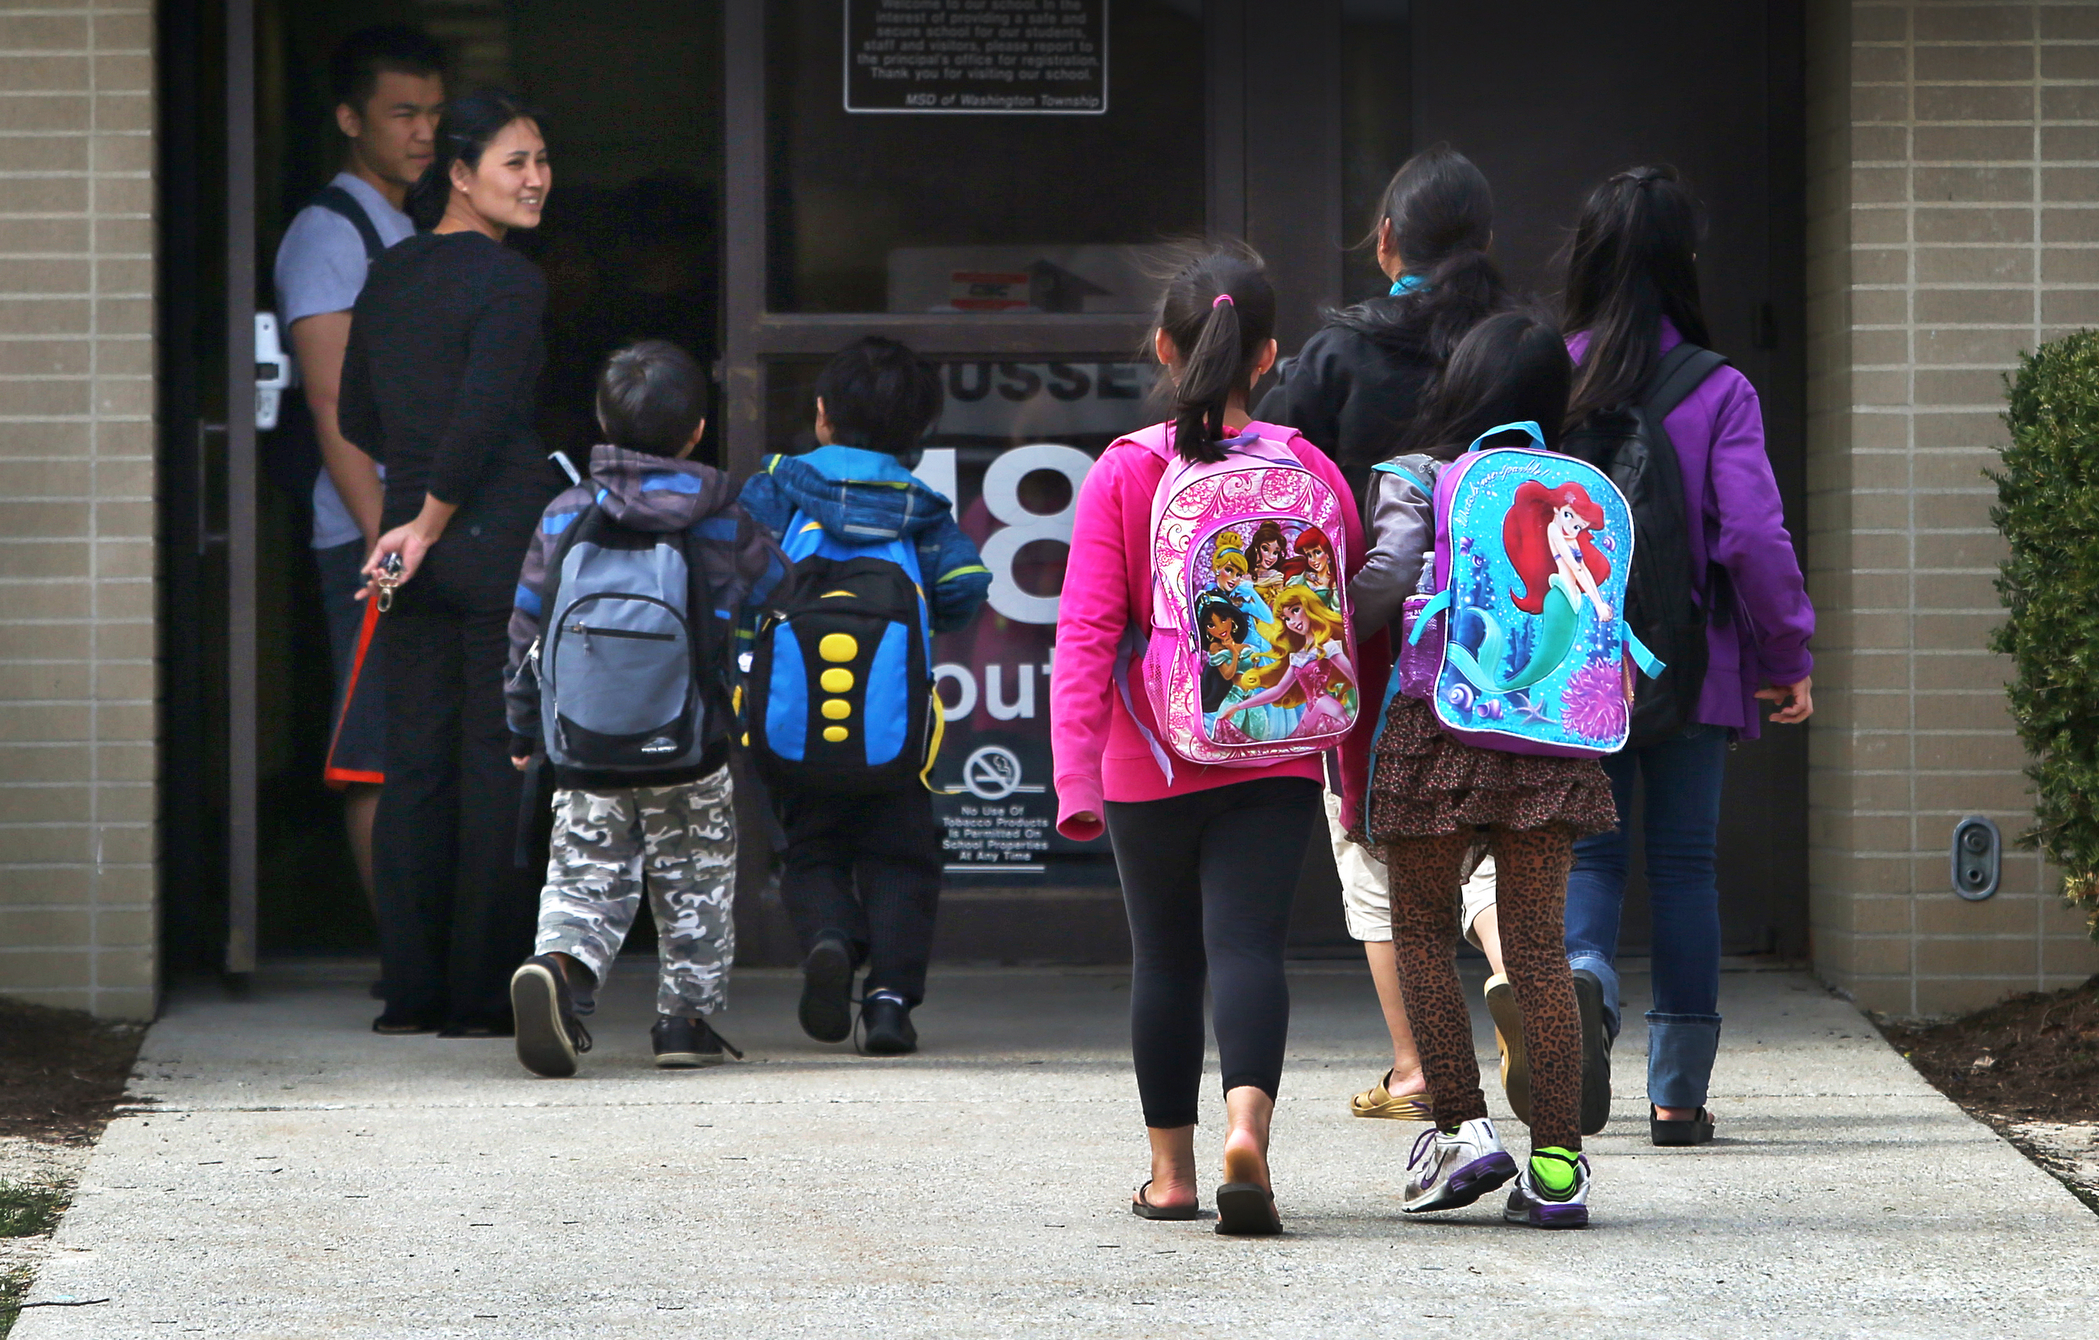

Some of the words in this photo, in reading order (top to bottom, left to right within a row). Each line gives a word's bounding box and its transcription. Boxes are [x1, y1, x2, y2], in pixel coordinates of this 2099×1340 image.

[881, 0, 940, 10] Welcome
[946, 0, 960, 10] to
[965, 1, 986, 10] our
[991, 0, 1038, 10] school.
[1043, 0, 1055, 10] In
[1060, 0, 1081, 10] the
[876, 13, 926, 24] interest
[931, 13, 945, 24] of
[950, 13, 1010, 26] providing
[1015, 15, 1023, 24] a
[1028, 13, 1057, 24] safe
[1062, 13, 1086, 24] and
[876, 28, 920, 38] secure
[926, 26, 970, 38] school
[975, 26, 993, 38] for
[999, 28, 1020, 38] our
[1025, 26, 1087, 39] students,
[864, 40, 895, 51] staff
[900, 40, 924, 51] and
[930, 40, 980, 53] visitors,
[985, 40, 1028, 54] please
[1034, 41, 1074, 54] report
[1080, 41, 1093, 51] to
[857, 54, 878, 65] the
[883, 54, 949, 67] principal's
[954, 54, 993, 65] office
[998, 54, 1016, 65] for
[1022, 54, 1100, 68] registration.
[872, 68, 909, 79] Thank
[915, 71, 939, 81] you
[944, 68, 962, 79] for
[968, 68, 1014, 81] visiting
[1018, 71, 1039, 79] our
[1045, 68, 1092, 80] school.
[905, 94, 937, 106] MSD
[941, 94, 955, 106] of
[960, 95, 1035, 108] Washington
[1041, 95, 1100, 108] Township
[949, 362, 1152, 401] USSE
[931, 647, 1056, 721] ou
[961, 806, 978, 816] No
[982, 806, 1005, 816] Use
[1010, 806, 1024, 816] Of
[943, 818, 992, 827] Tobacco
[996, 818, 1048, 827] Products
[949, 829, 959, 838] Is
[964, 829, 1020, 838] Permitted
[1024, 829, 1042, 838] On
[942, 840, 983, 849] School
[988, 840, 1049, 851] Properties
[959, 851, 972, 861] At
[976, 851, 998, 862] Any
[1004, 851, 1031, 861] Time
